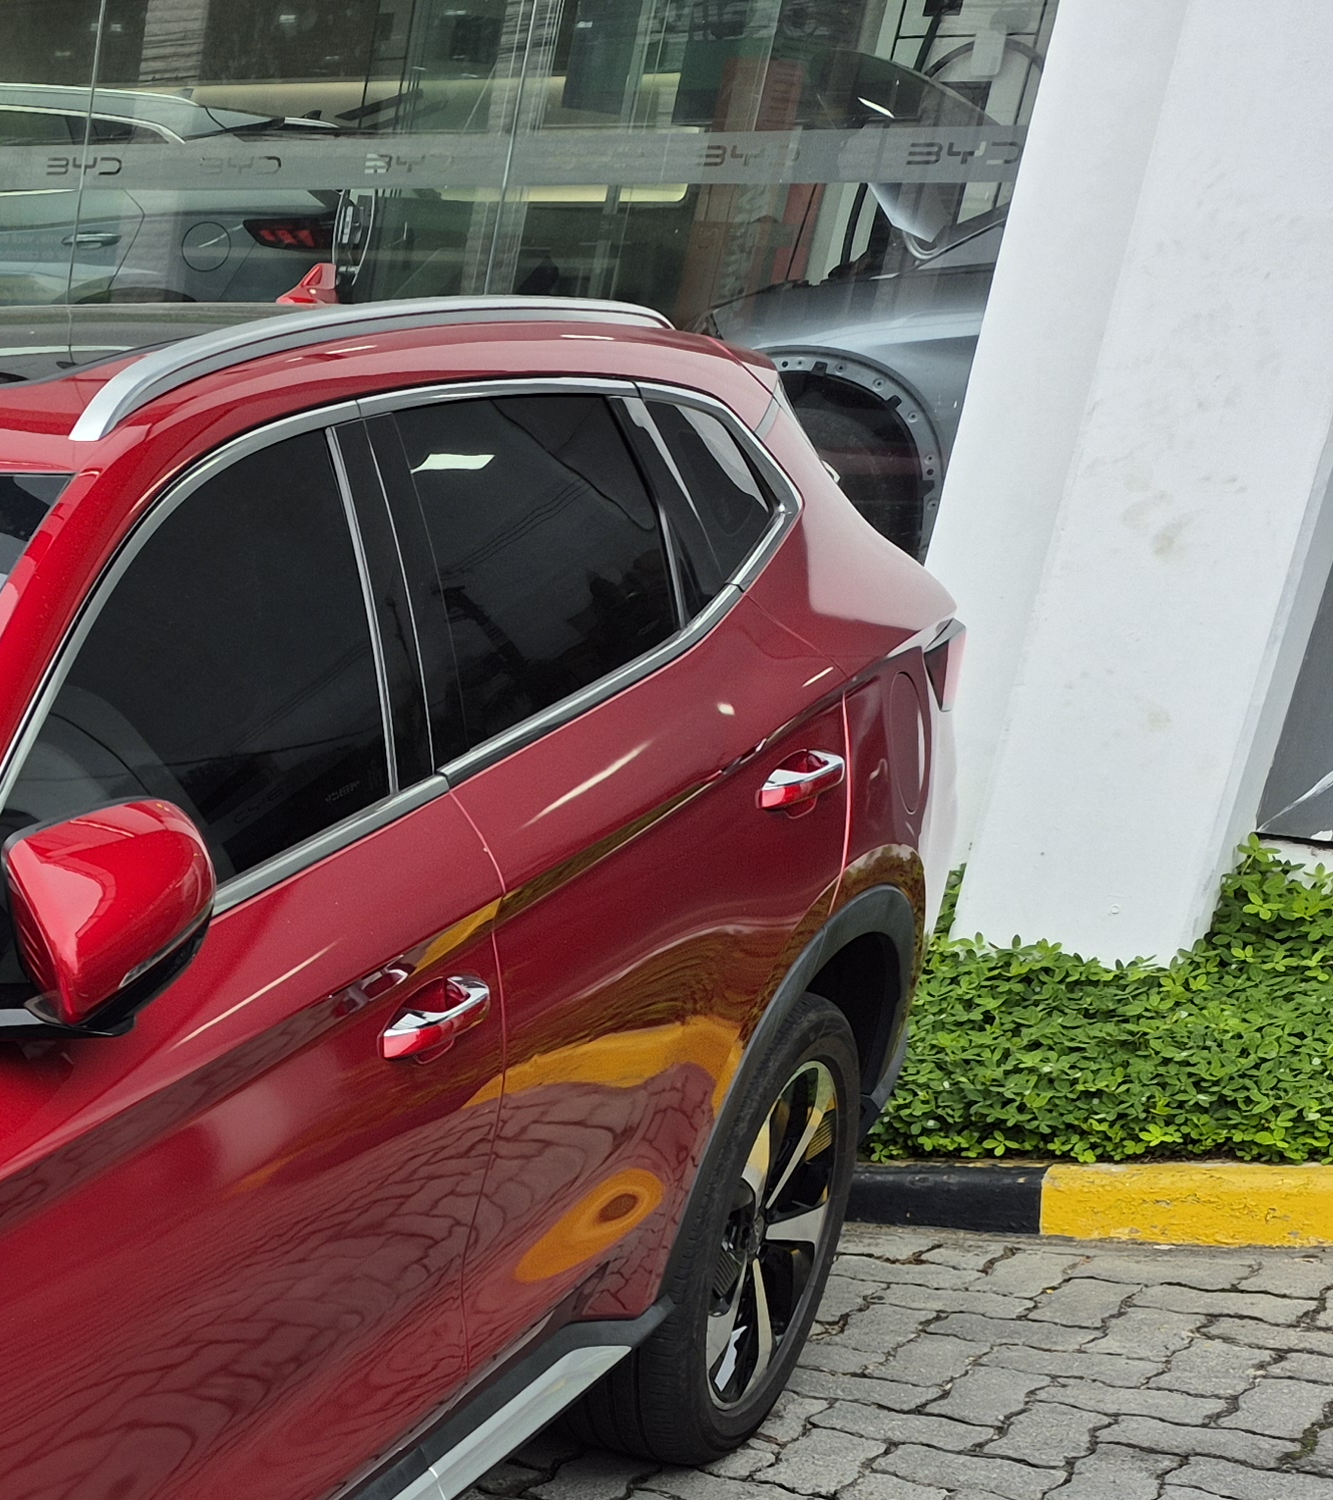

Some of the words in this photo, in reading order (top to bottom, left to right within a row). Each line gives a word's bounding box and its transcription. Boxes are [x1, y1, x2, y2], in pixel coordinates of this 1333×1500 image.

[46, 156, 123, 176] BYD
[203, 156, 282, 177] BYD
[906, 141, 1020, 167] BYD
